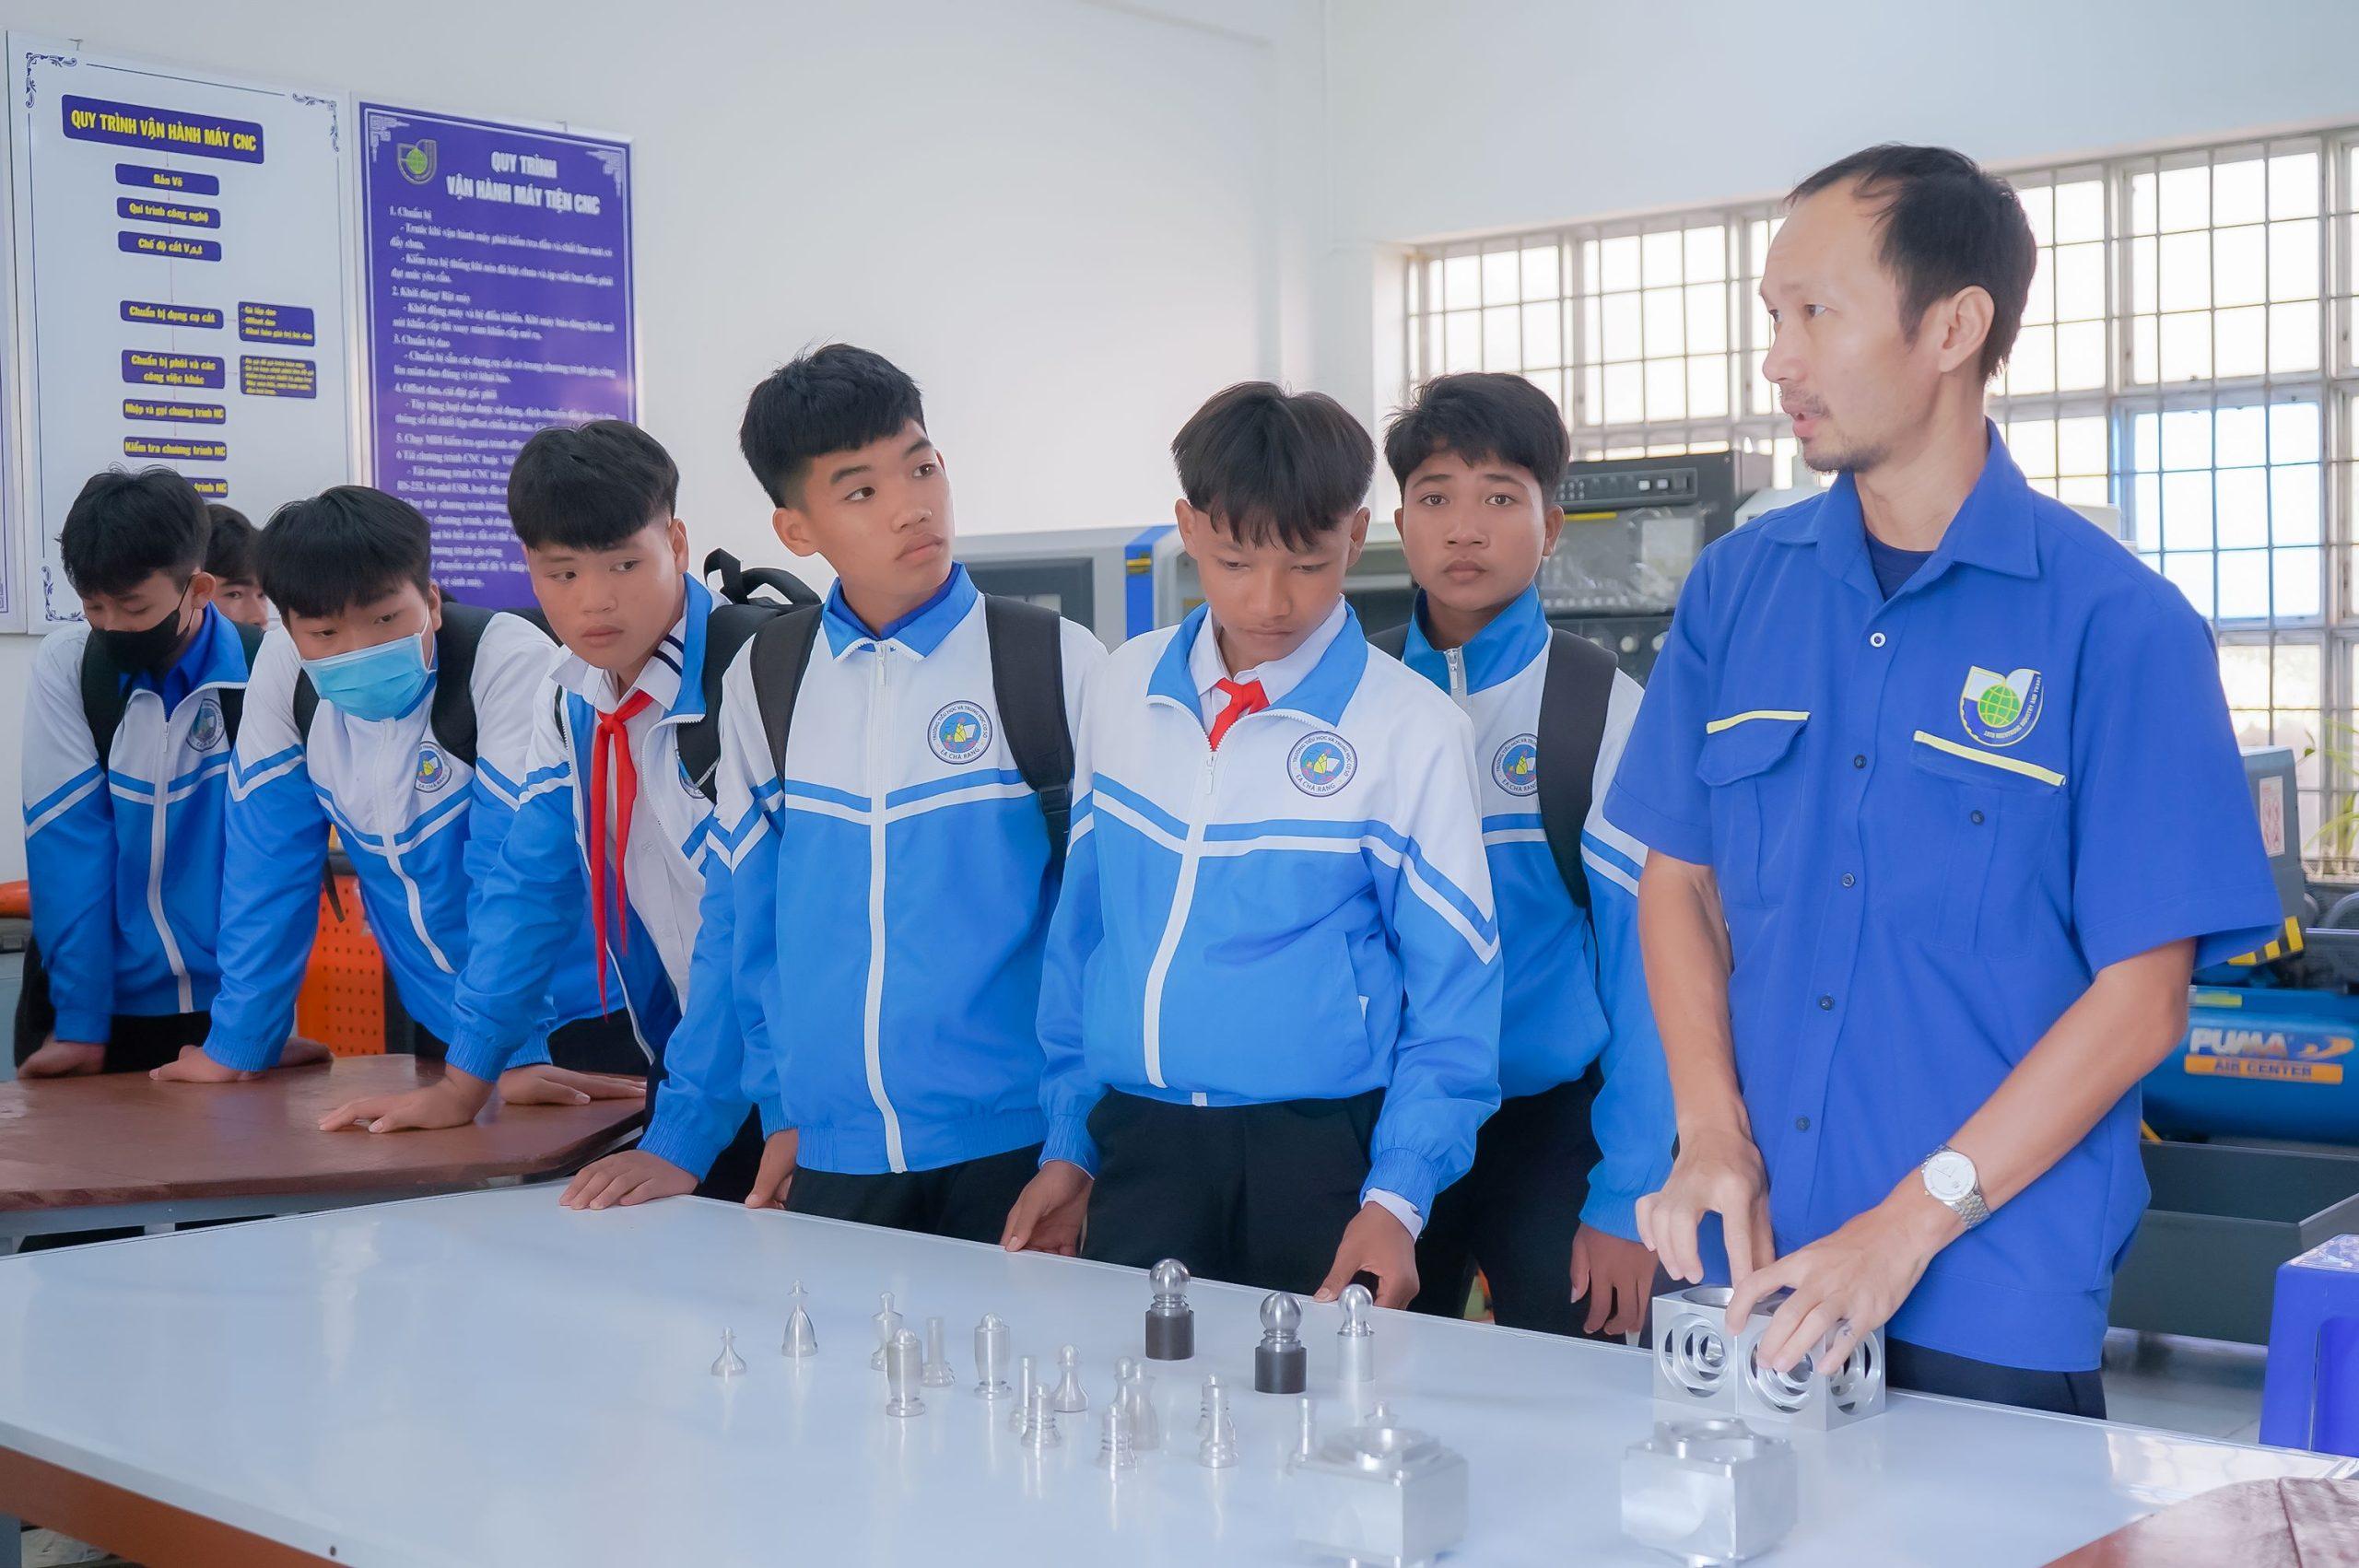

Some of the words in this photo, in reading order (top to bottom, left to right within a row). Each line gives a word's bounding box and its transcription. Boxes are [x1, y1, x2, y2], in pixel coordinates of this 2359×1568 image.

[71, 109, 97, 130] QUY
[100, 111, 136, 135] TRÌNH
[140, 117, 166, 140] VẬN
[168, 120, 201, 145] HÀNH
[205, 126, 229, 147] MÁY
[232, 133, 257, 151] CNC
[490, 151, 517, 173] QUY
[519, 153, 557, 179] TRÌNH
[446, 173, 474, 201] VẬN
[475, 178, 511, 203] HÀNH
[513, 183, 543, 207] MÁY
[545, 187, 573, 214] TIỆN
[574, 193, 601, 216] CNC
[145, 205, 166, 217] trình
[167, 208, 187, 221] công
[188, 210, 209, 224] nghệ
[940, 749, 948, 757] EA
[963, 747, 980, 759] RANG
[1318, 783, 1336, 792] RANG
[2190, 1027, 2288, 1058] PUMA
[2213, 1059, 2241, 1072] AIR
[2248, 1061, 2312, 1077] CENTER
